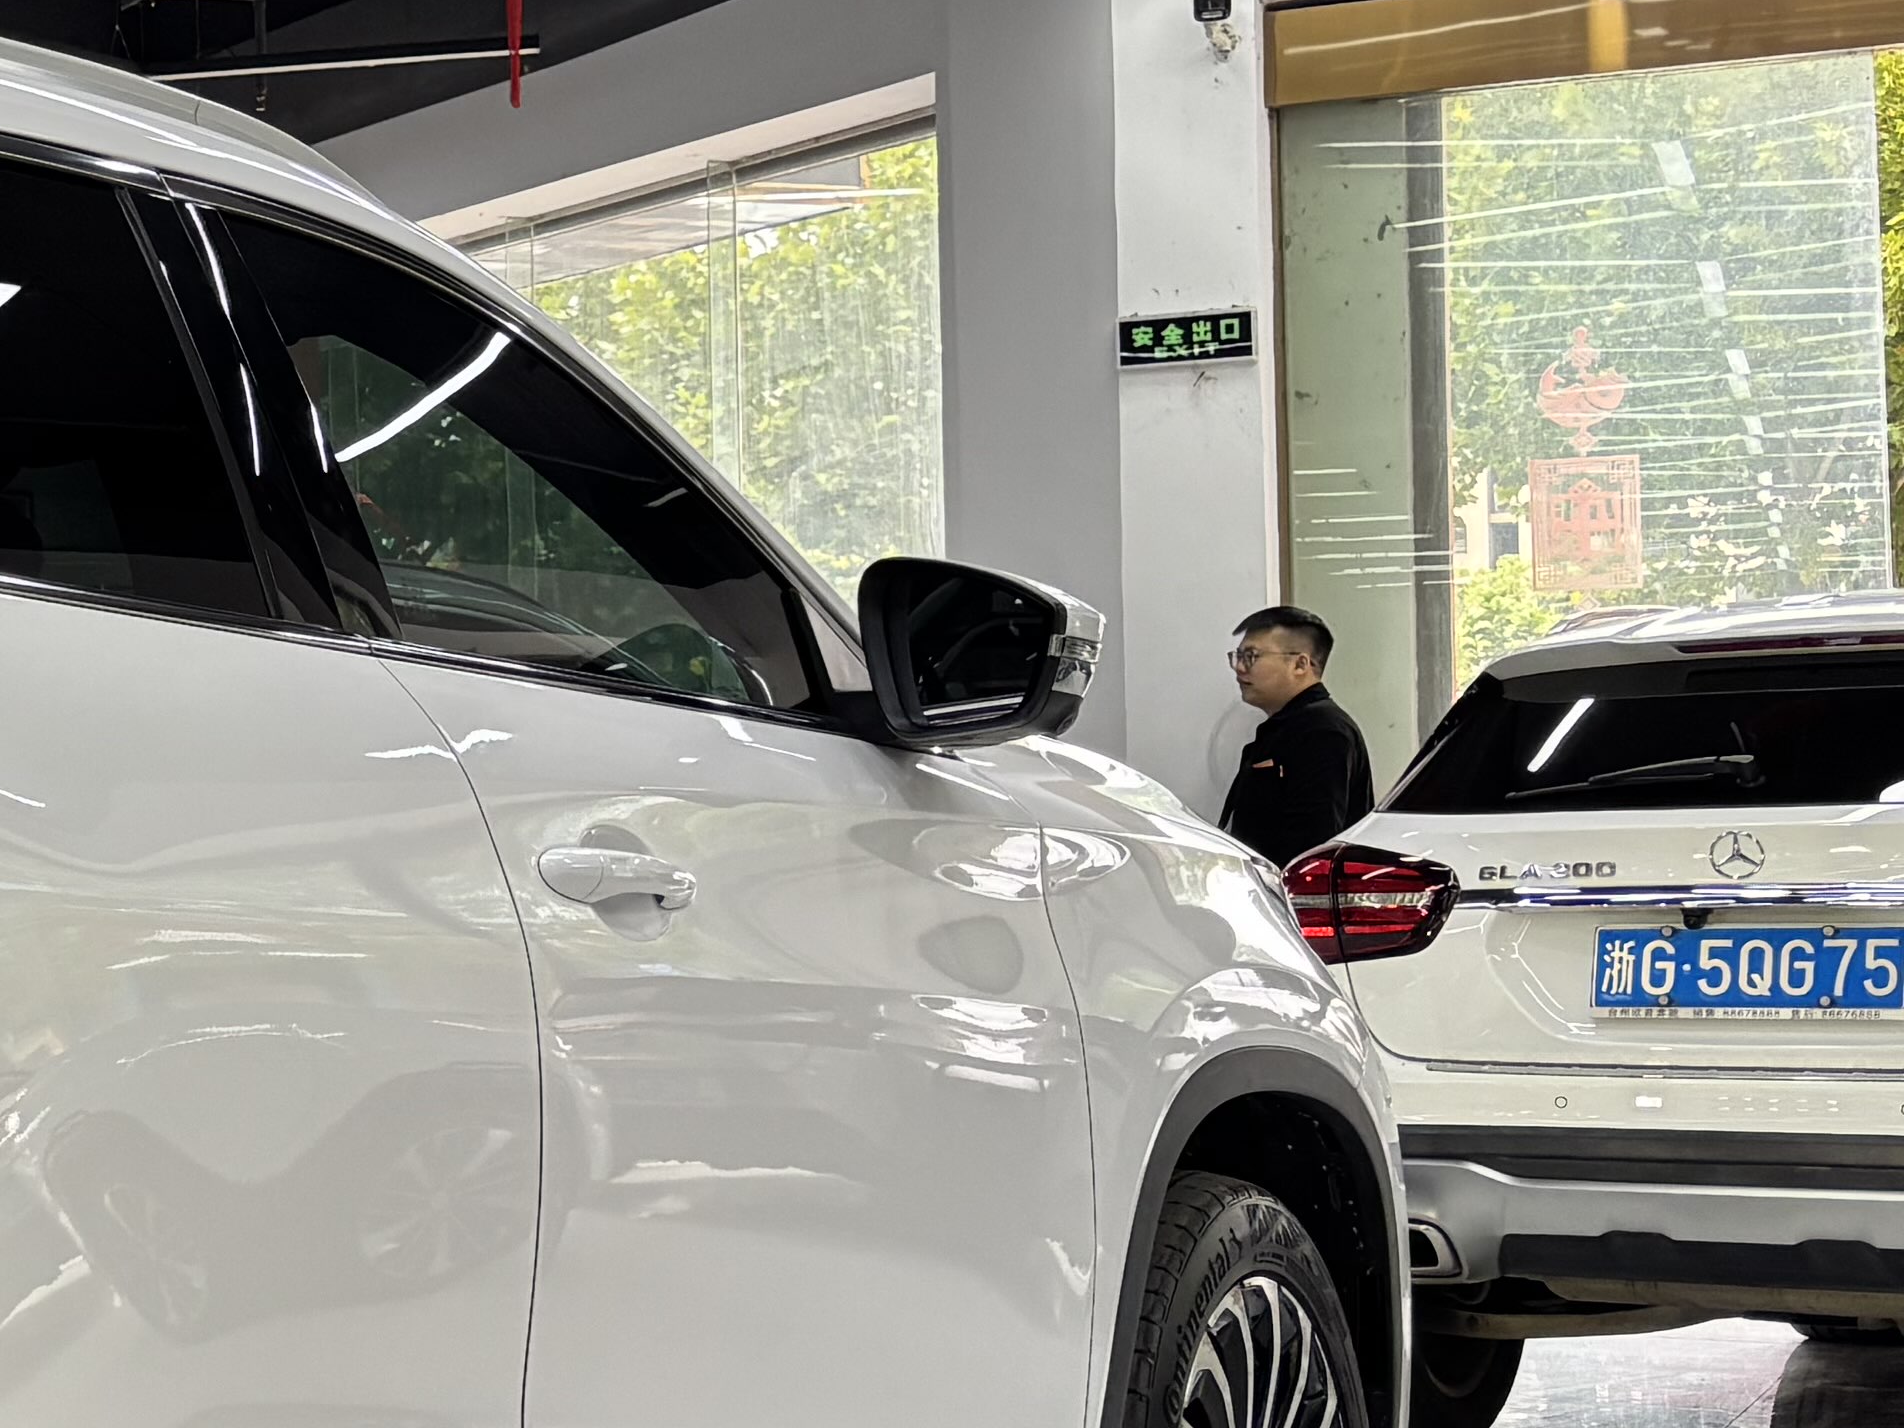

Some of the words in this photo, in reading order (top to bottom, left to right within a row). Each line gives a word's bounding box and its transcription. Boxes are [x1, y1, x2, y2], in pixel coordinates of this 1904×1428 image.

[1132, 318, 1239, 347] 安全出口
[1154, 342, 1219, 358] EXIT
[1478, 864, 1541, 881] GLA
[1601, 939, 1900, 997] 浙G·5QG75
